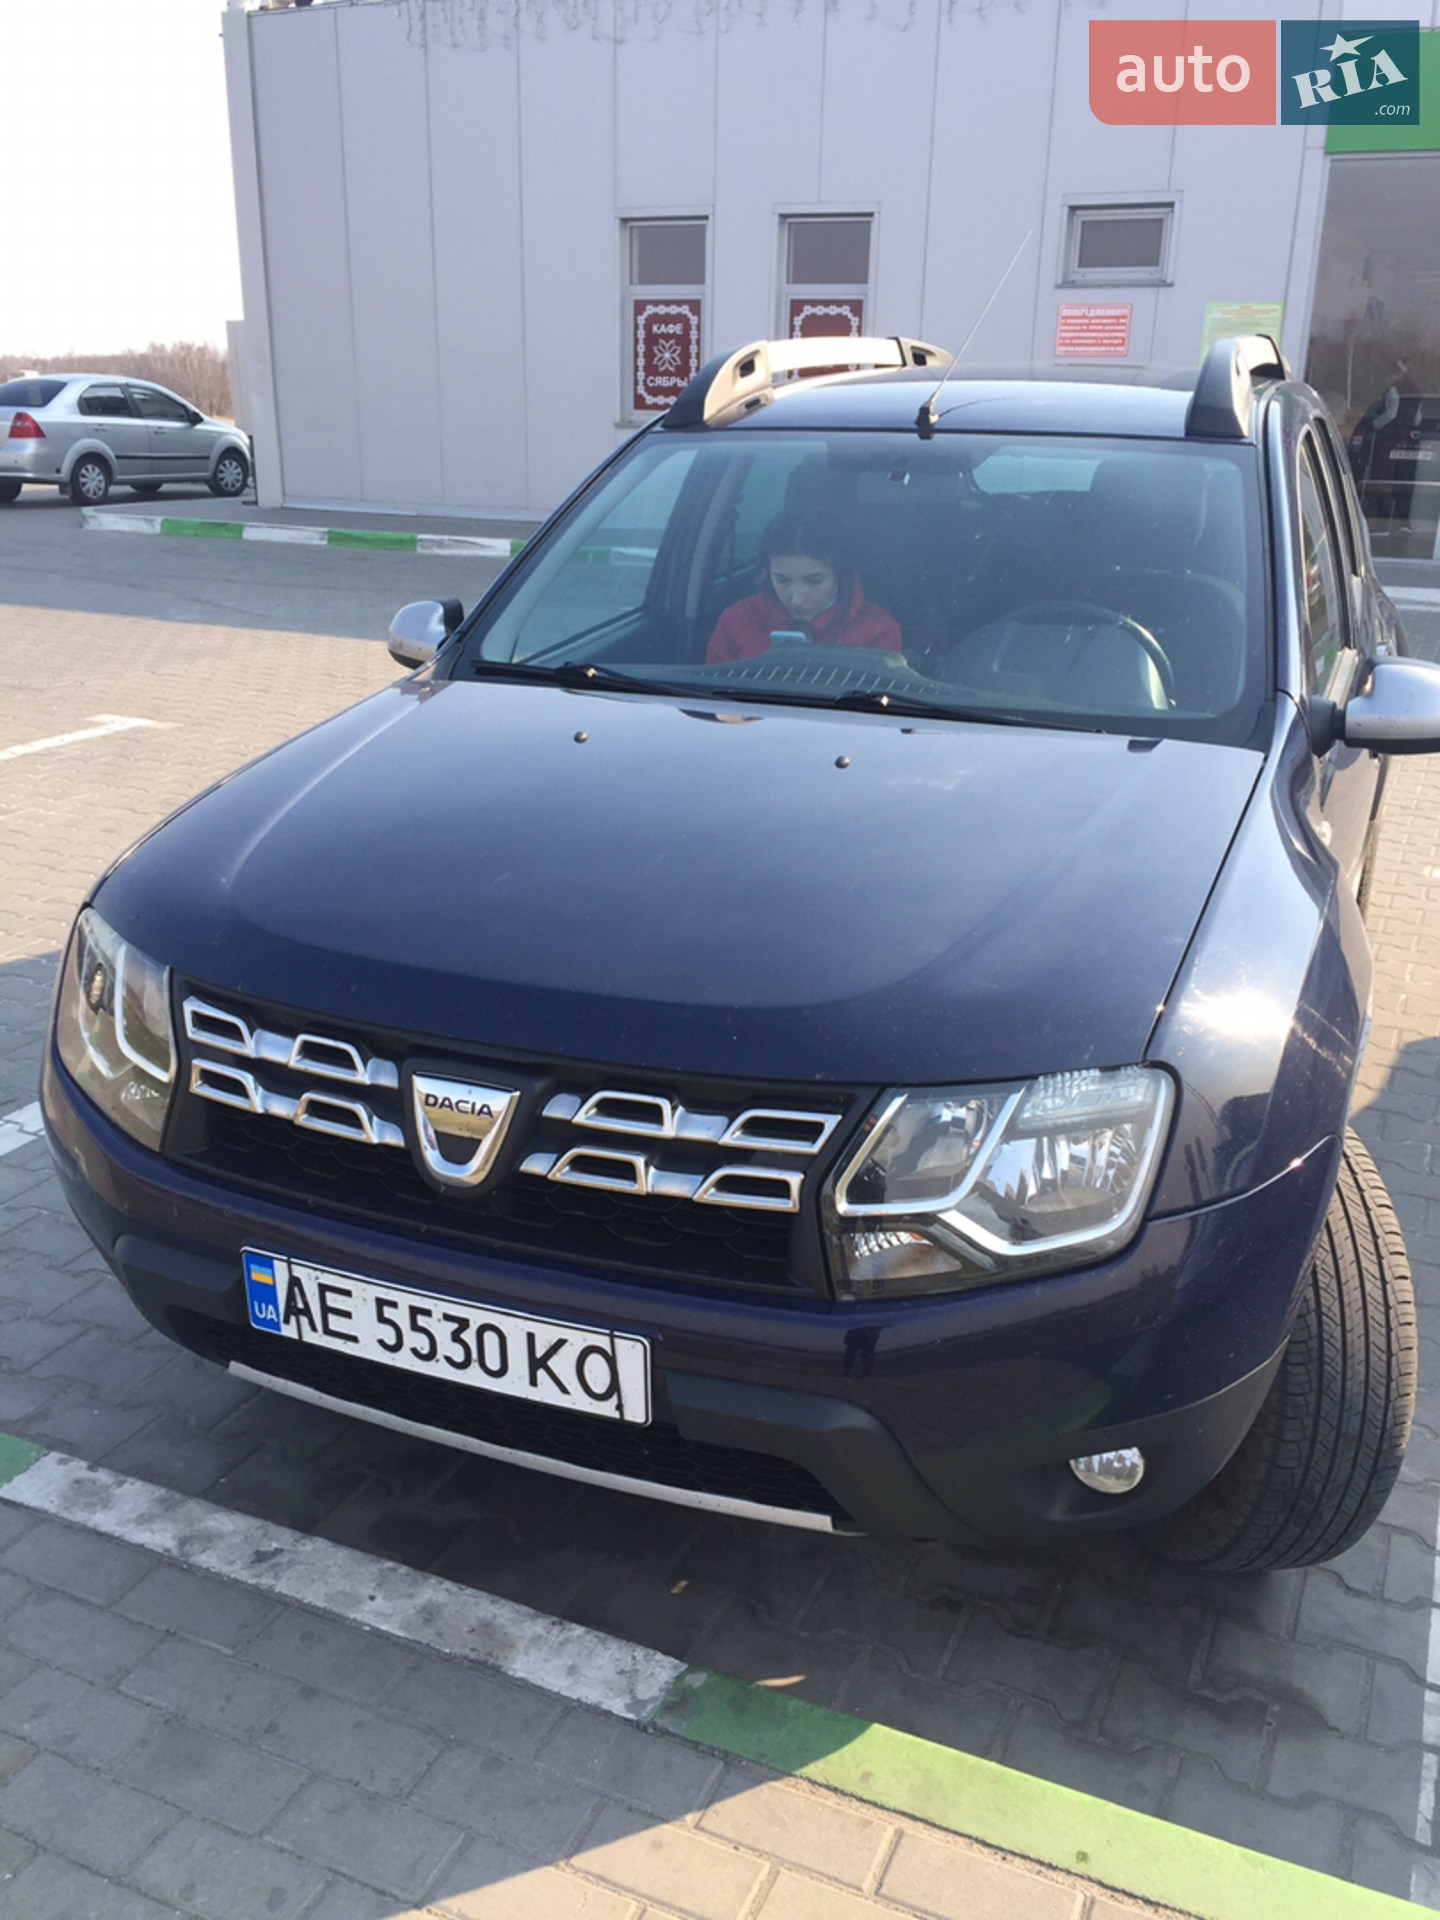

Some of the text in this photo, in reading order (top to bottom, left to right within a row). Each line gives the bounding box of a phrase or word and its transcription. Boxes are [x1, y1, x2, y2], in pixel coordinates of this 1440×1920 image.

[652, 323, 684, 335] КАФЕ
[646, 376, 689, 387] СЯБРЫ
[424, 1093, 494, 1119] DACIA
[254, 1300, 278, 1323] UA
[283, 1275, 619, 1402] AE 5530 KO
